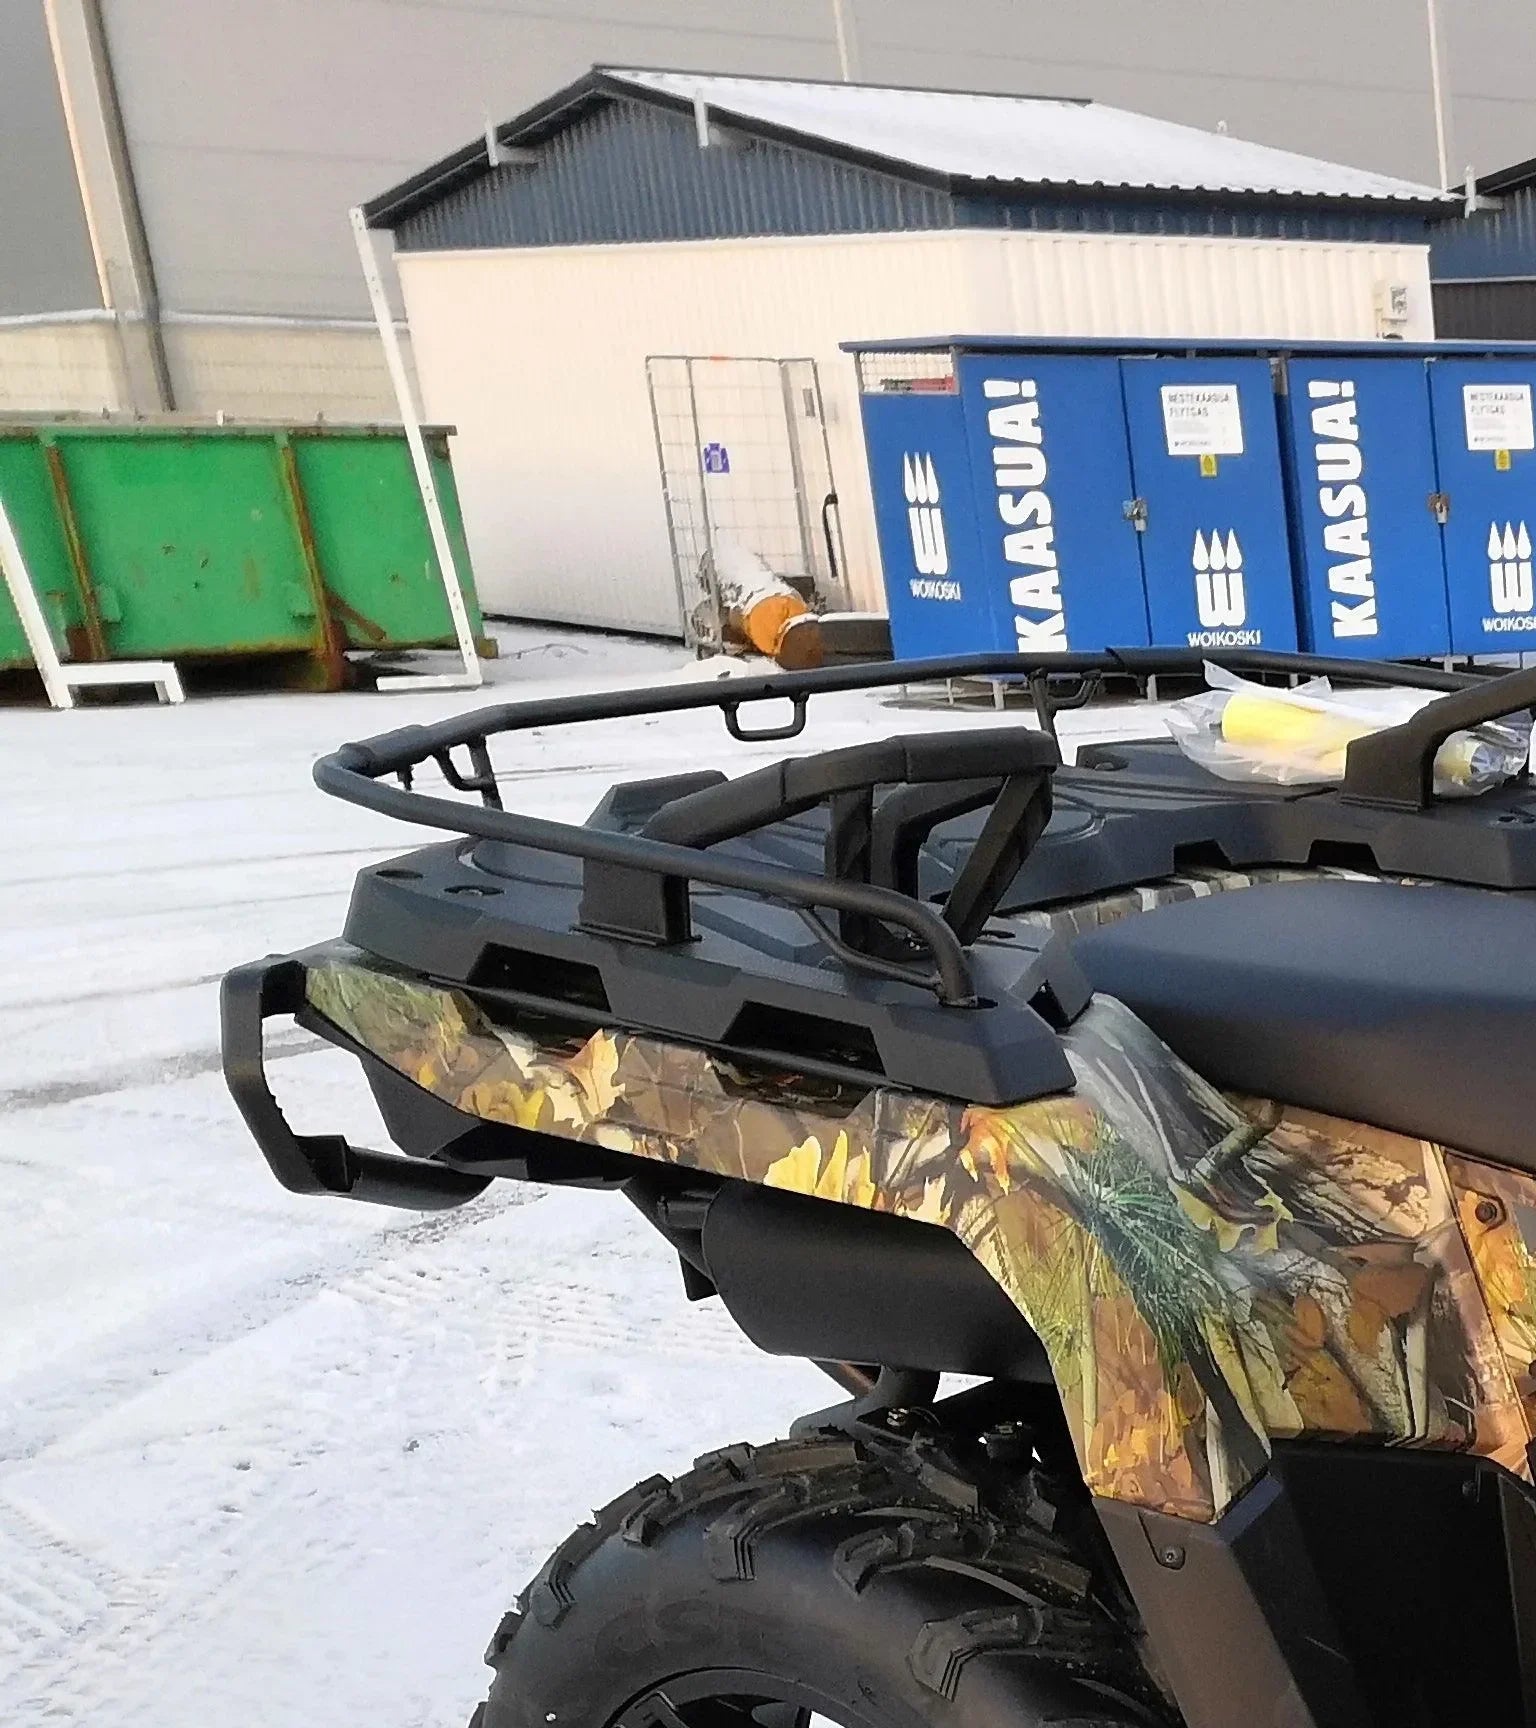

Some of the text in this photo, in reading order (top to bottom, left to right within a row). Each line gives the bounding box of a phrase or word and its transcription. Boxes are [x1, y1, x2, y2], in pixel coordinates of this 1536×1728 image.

[984, 380, 1068, 653] KAASUA!
[1308, 381, 1378, 638] KAASUA!
[1187, 629, 1262, 648] WOIKOSKI
